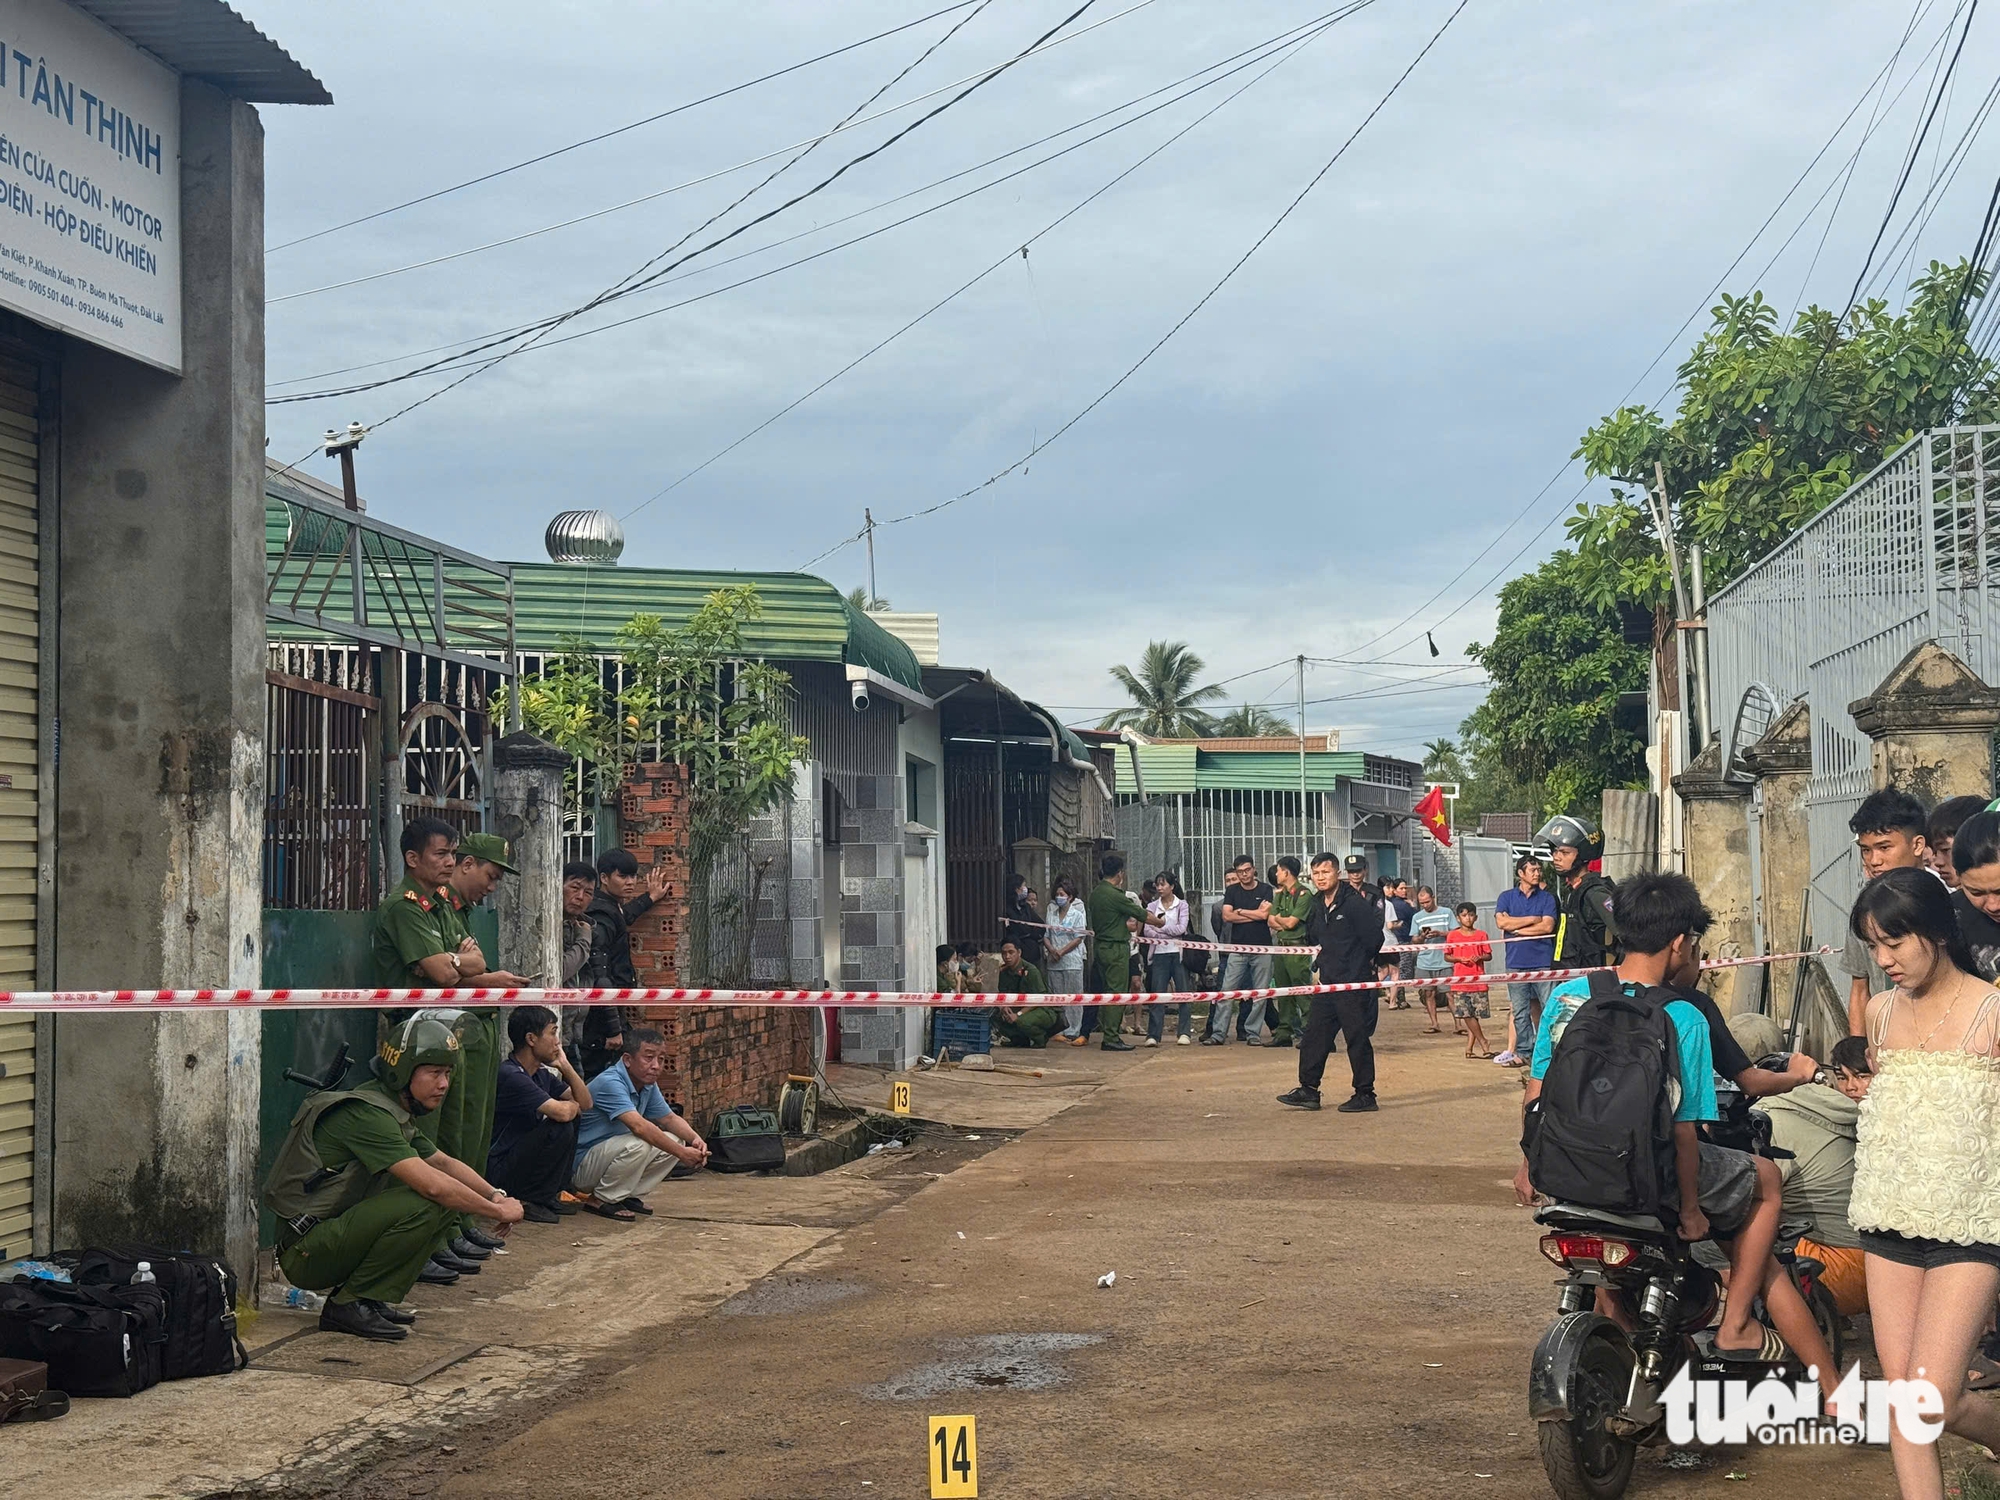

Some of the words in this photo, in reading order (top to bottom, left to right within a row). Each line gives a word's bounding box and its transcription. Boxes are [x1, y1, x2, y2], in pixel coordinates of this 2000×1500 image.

[13, 49, 73, 126] TÂN
[80, 88, 161, 175] THỊNH
[23, 150, 56, 188] CỬA
[59, 176, 102, 211] CUỐN
[112, 196, 162, 242] MOTOR
[44, 201, 77, 236] HỘP
[115, 236, 156, 276] KHIỂN
[29, 279, 46, 296] 0905
[47, 287, 59, 302] 501
[60, 294, 74, 308] 404
[79, 301, 95, 317] 0934
[96, 308, 109, 323] 866
[111, 314, 123, 328] 466
[109, 292, 118, 305] Ma
[896, 1086, 908, 1108] 13
[935, 1426, 971, 1484] 14
